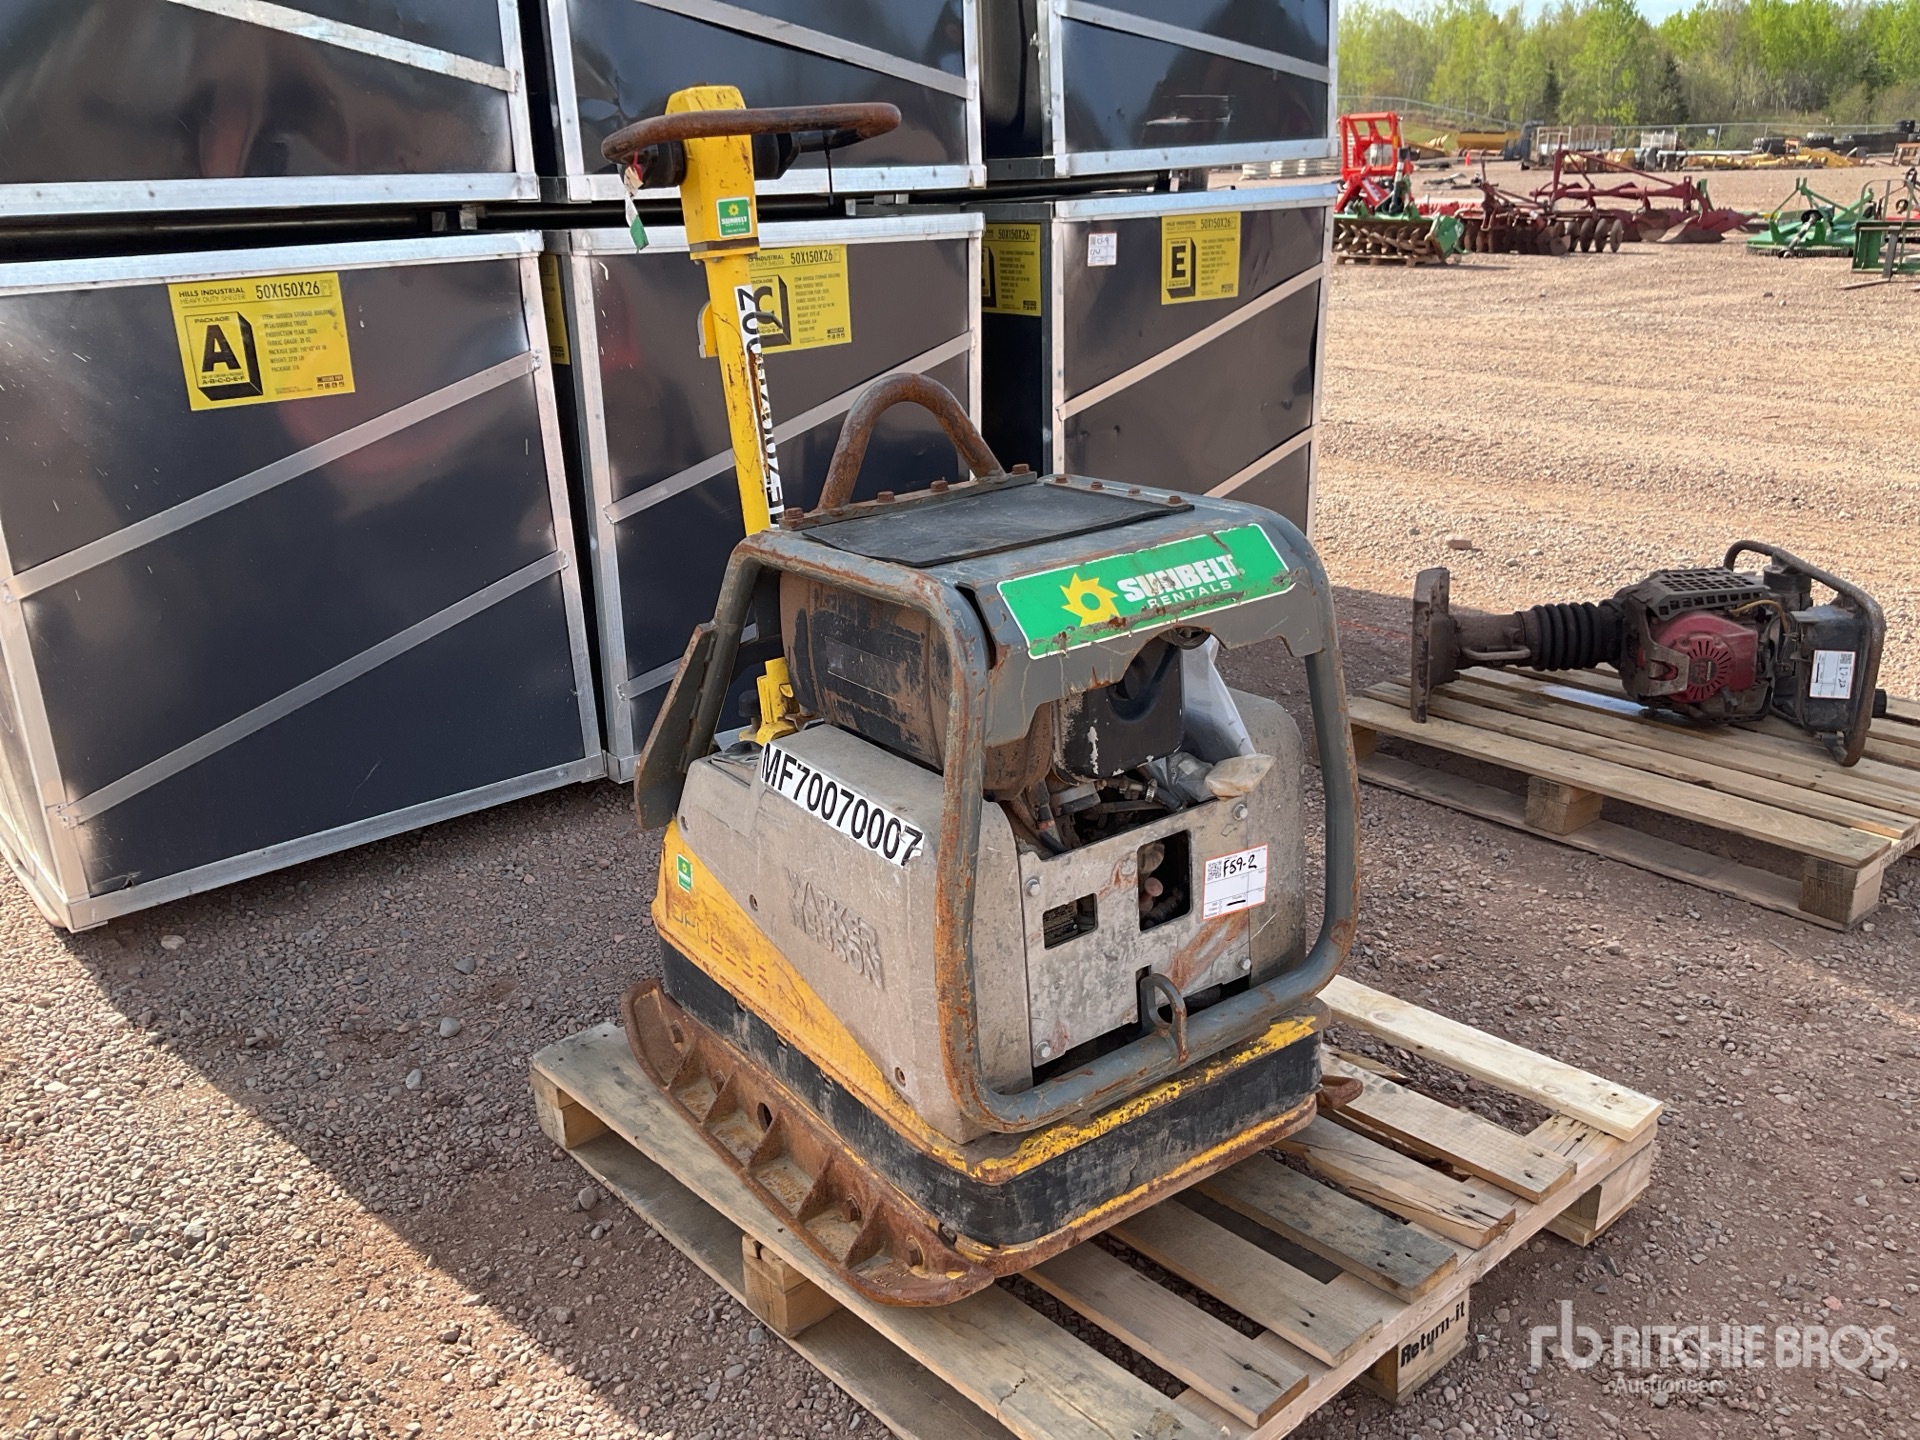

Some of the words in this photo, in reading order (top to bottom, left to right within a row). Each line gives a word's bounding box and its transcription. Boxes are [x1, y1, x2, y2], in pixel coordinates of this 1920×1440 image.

[790, 249, 833, 265] 50X150X26
[1171, 245, 1186, 278] E
[179, 289, 199, 297] HILLS
[201, 287, 245, 296] INDUSTRIAL
[255, 281, 320, 299] 50X150X26
[221, 293, 246, 302] SHELTER
[753, 286, 775, 324] C
[194, 315, 230, 324] PACKAGE
[201, 324, 242, 372] A
[1117, 553, 1238, 603] SUNBELT
[1147, 579, 1232, 609] RENTALS
[761, 742, 923, 867] MF70070007
[1400, 1300, 1465, 1368] Return-it
